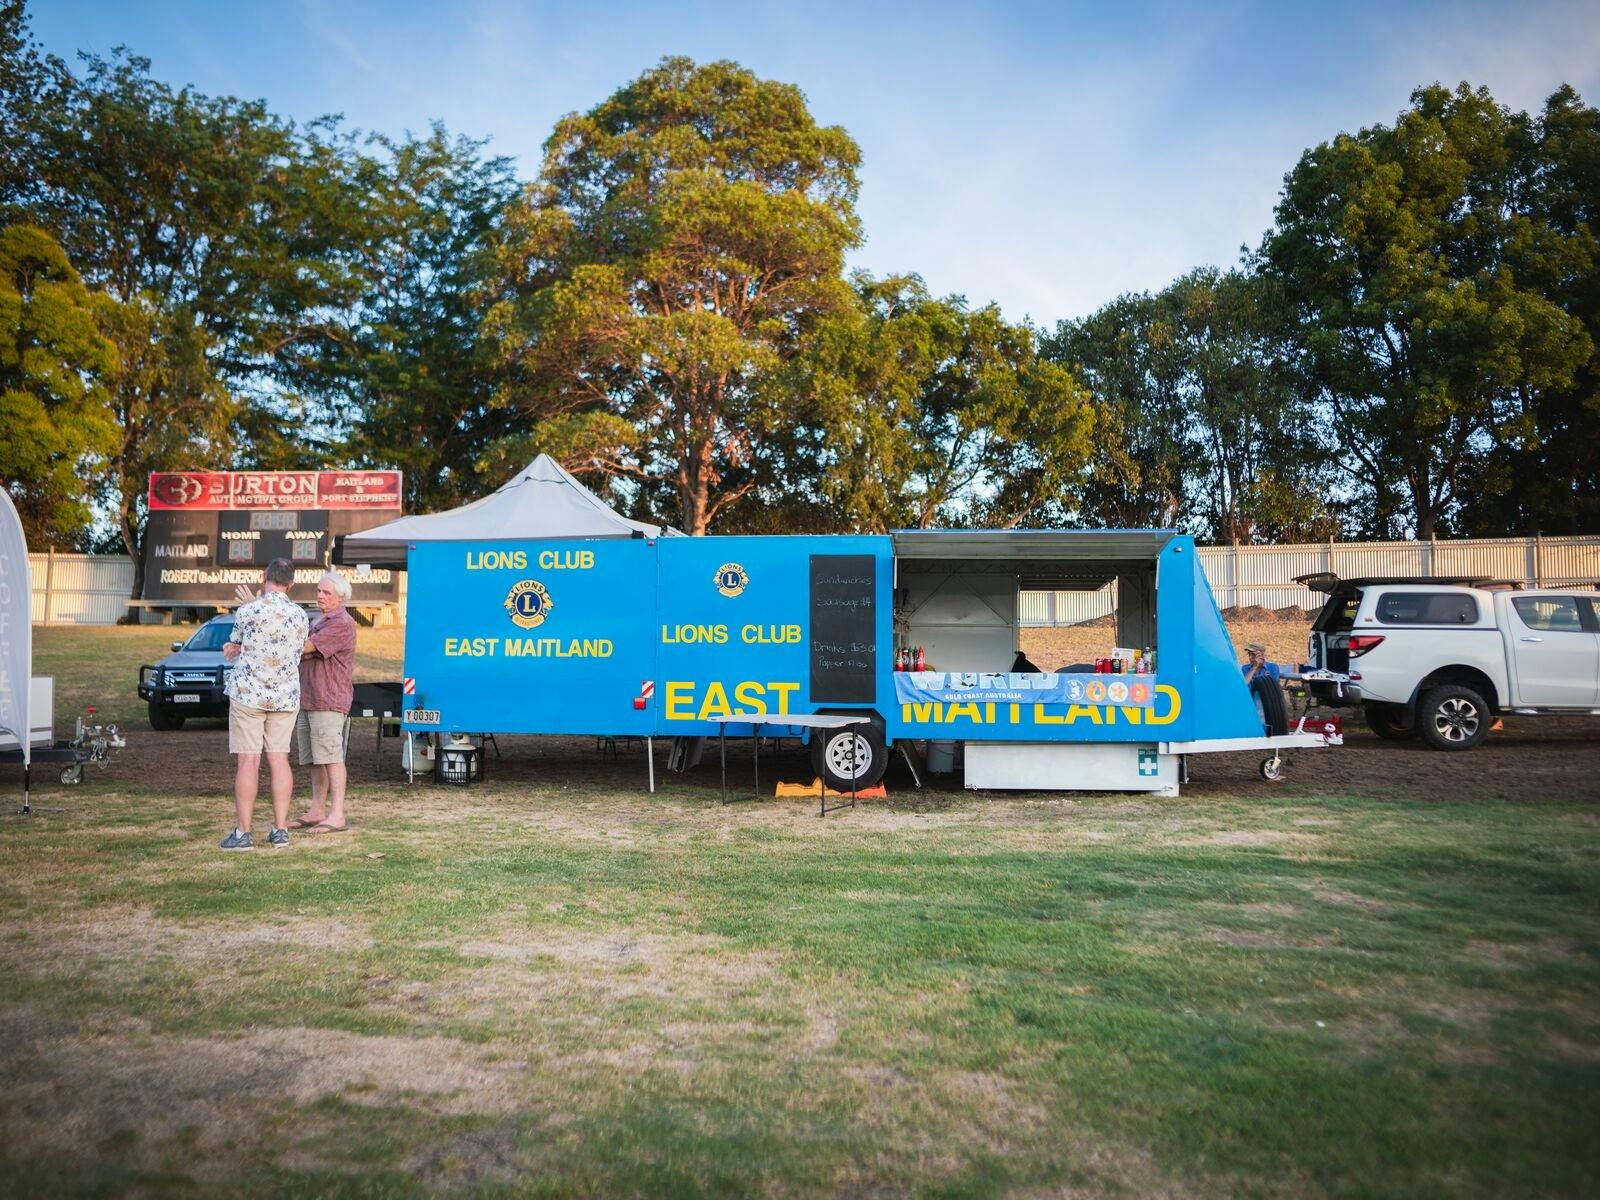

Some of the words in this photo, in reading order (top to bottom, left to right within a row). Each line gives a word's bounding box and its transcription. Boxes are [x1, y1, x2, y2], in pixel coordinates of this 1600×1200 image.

[209, 495, 277, 505] AUTMOTIVE
[278, 495, 314, 504] GROUP
[321, 494, 348, 503] PORT
[221, 531, 261, 540] HOME
[285, 531, 325, 540] AWAY
[155, 543, 209, 558] MAITLAND
[466, 550, 528, 570] LIONS
[538, 551, 595, 569] CLUB
[160, 569, 199, 584] ROBERT
[727, 573, 737, 586] L
[515, 581, 544, 592] LIONS
[523, 594, 536, 613] L
[662, 624, 728, 643] LIONS
[741, 625, 802, 643] CLUB
[444, 638, 499, 657] EAST
[504, 639, 613, 658] MAITLAND
[665, 681, 800, 721] EAST
[963, 692, 983, 700] COAST
[985, 691, 1022, 699] AUSTRALIA
[406, 710, 412, 721] Y
[413, 711, 440, 722] 00307
